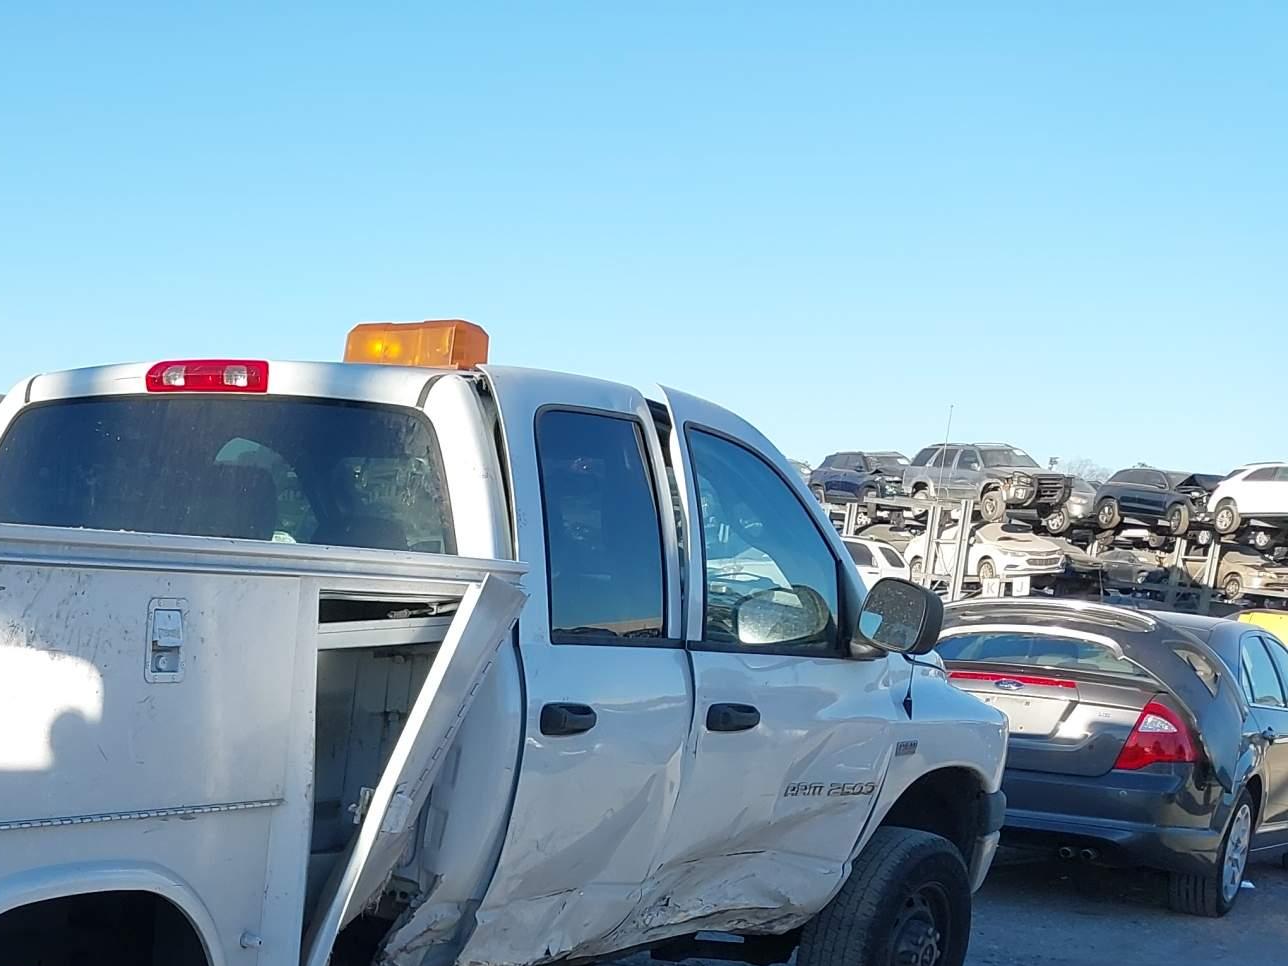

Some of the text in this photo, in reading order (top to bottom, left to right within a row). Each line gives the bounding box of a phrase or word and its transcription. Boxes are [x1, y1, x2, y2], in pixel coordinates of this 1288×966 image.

[987, 582, 995, 593] K
[1016, 581, 1024, 592] J
[784, 782, 877, 797] RAM 2500
